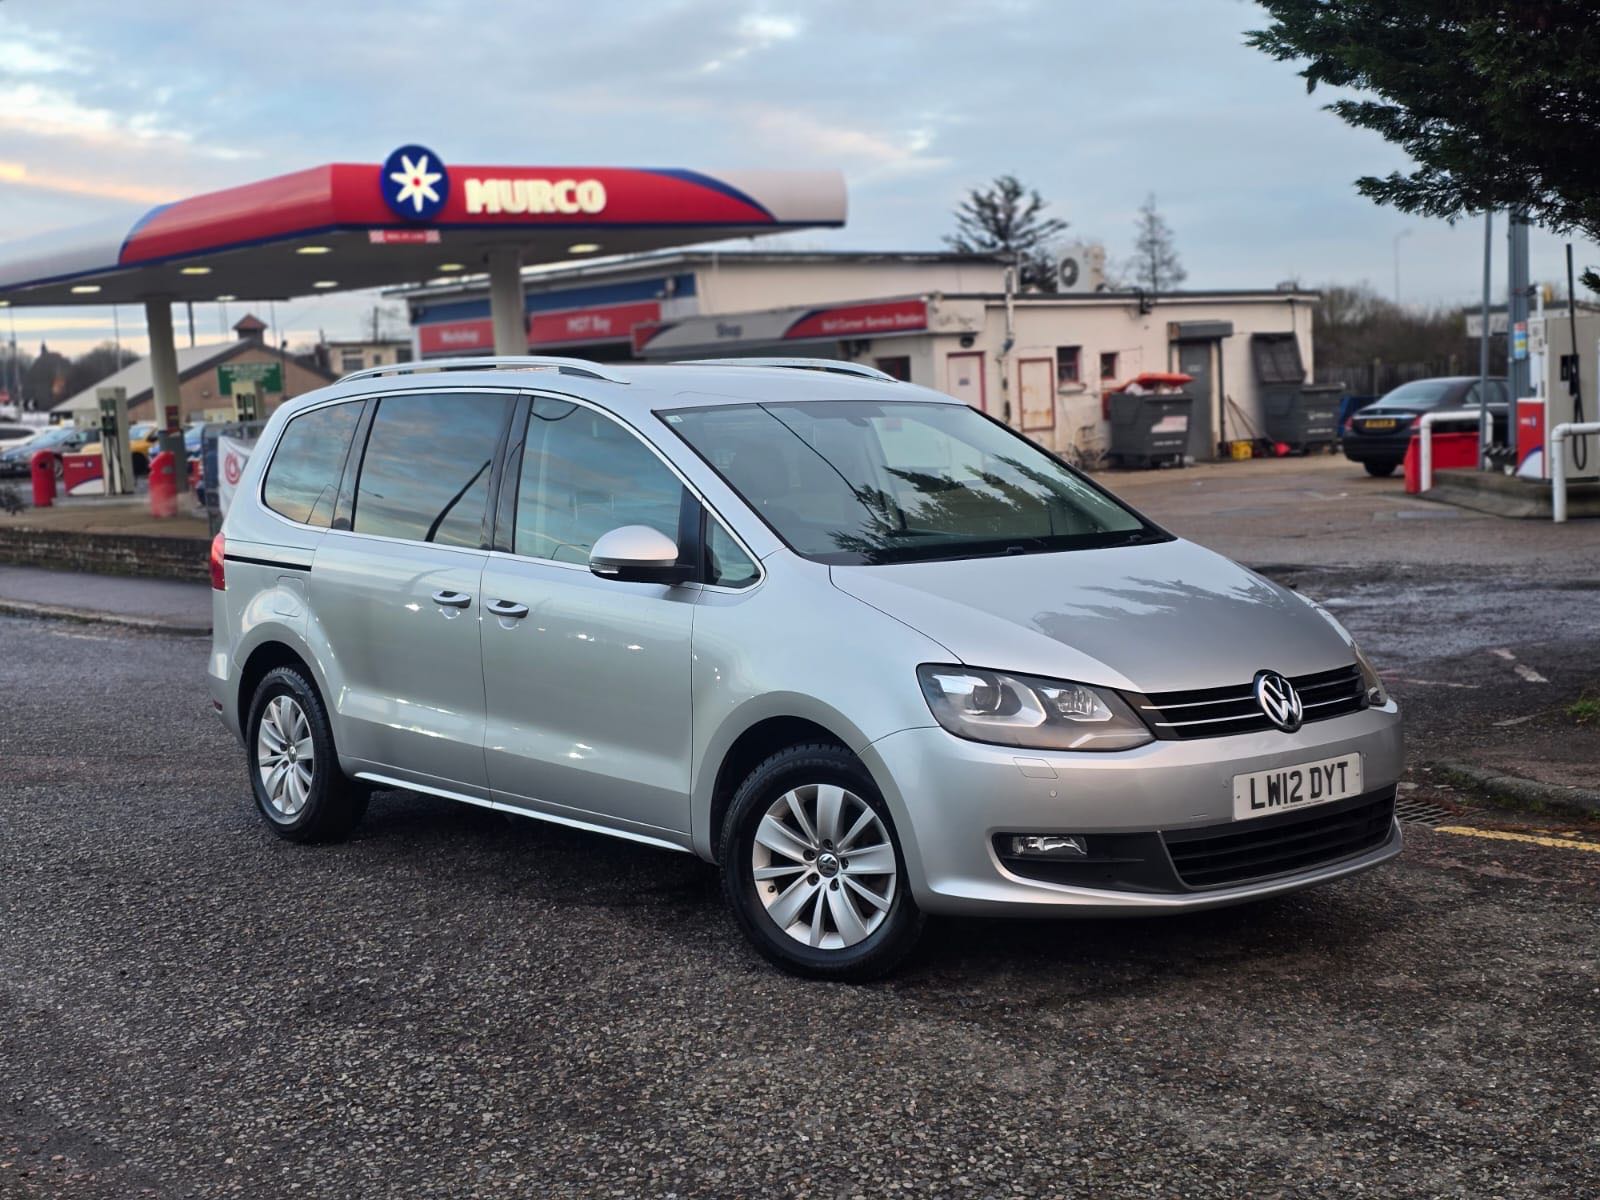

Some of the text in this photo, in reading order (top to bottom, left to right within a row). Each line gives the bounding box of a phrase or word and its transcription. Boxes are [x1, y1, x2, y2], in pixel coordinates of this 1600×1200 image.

[464, 178, 607, 214] MURCO
[716, 322, 741, 338] Shop
[1250, 761, 1348, 809] LW12 DYT
